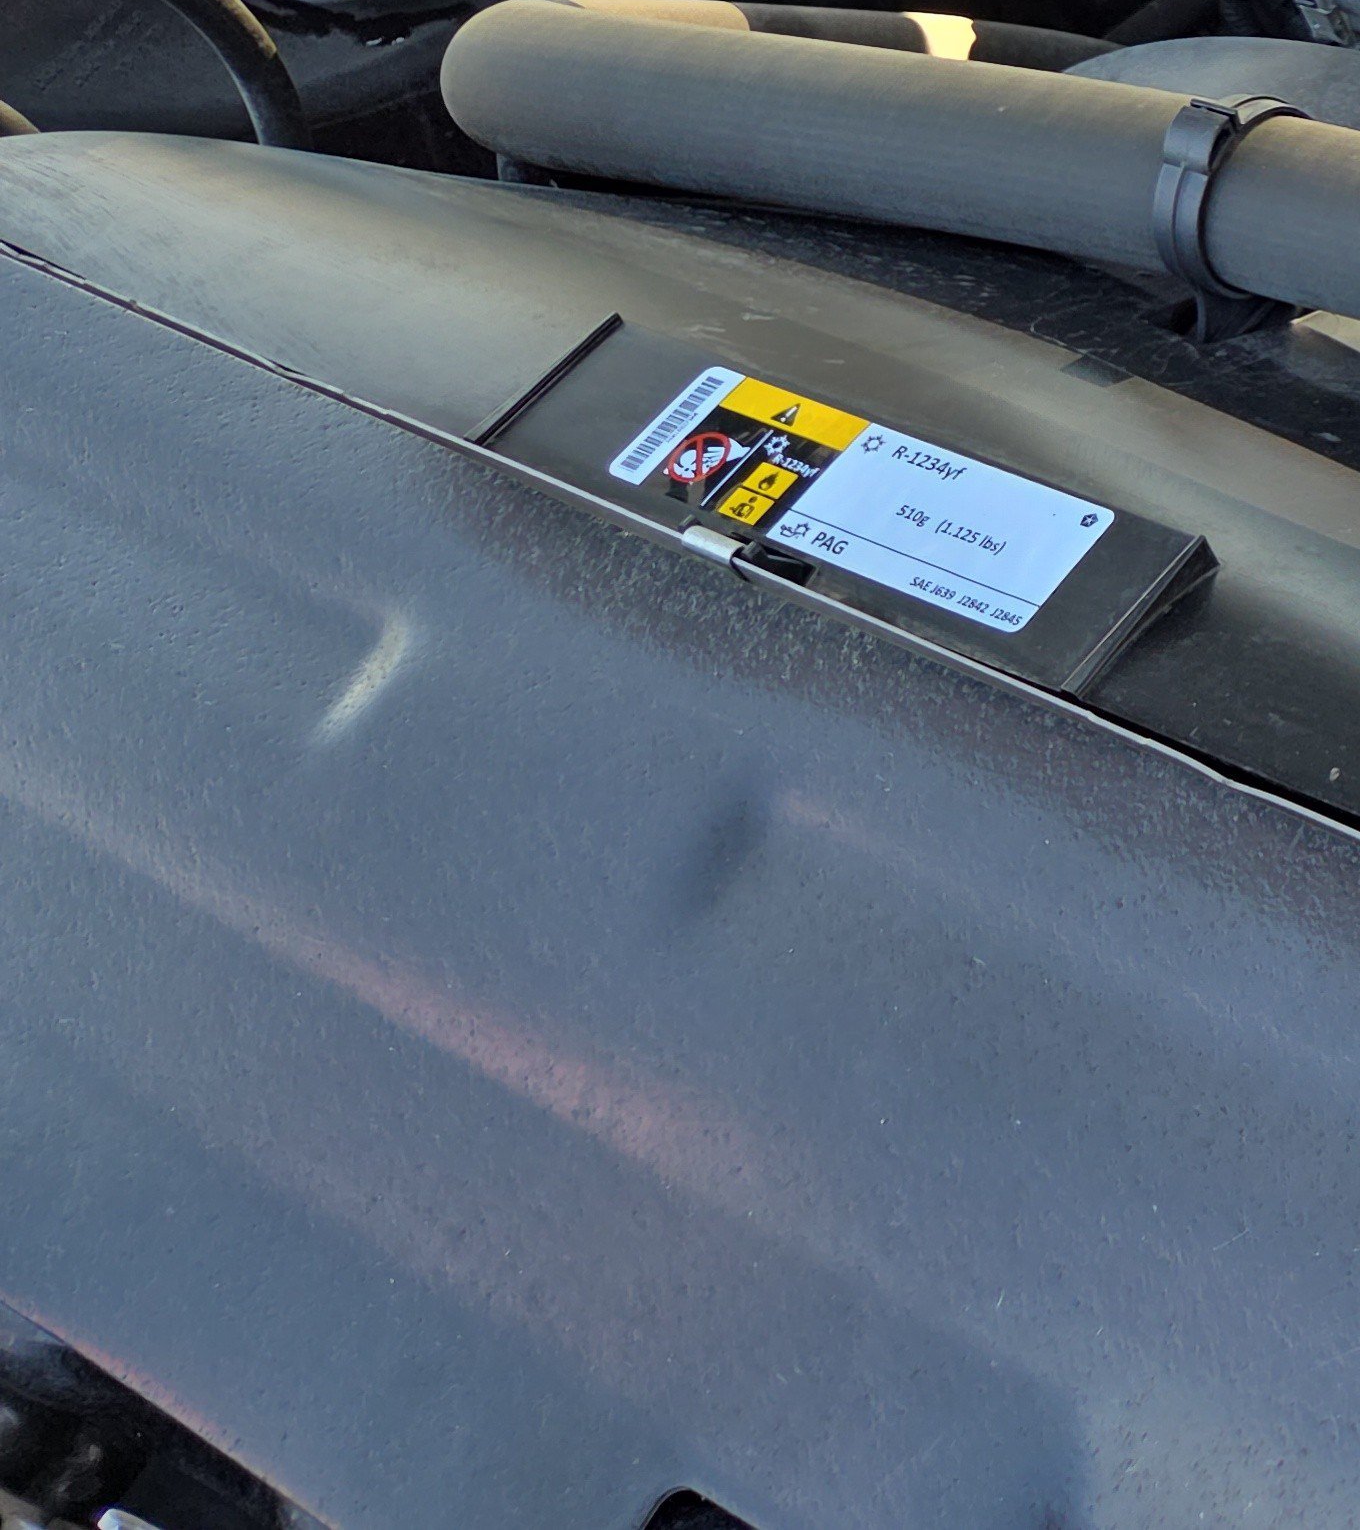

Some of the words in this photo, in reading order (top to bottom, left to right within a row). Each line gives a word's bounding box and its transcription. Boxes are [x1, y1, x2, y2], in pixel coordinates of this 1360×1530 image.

[772, 453, 821, 479] R-1234yf
[891, 445, 968, 481] R-1234yf
[811, 531, 849, 556] PAG
[896, 504, 931, 528] 510g
[934, 518, 982, 544] (1.125
[978, 534, 1007, 556] lbs)
[909, 576, 933, 592] SAE
[930, 584, 957, 600] J639
[956, 595, 990, 614] J2842
[989, 607, 1024, 626] J2845
